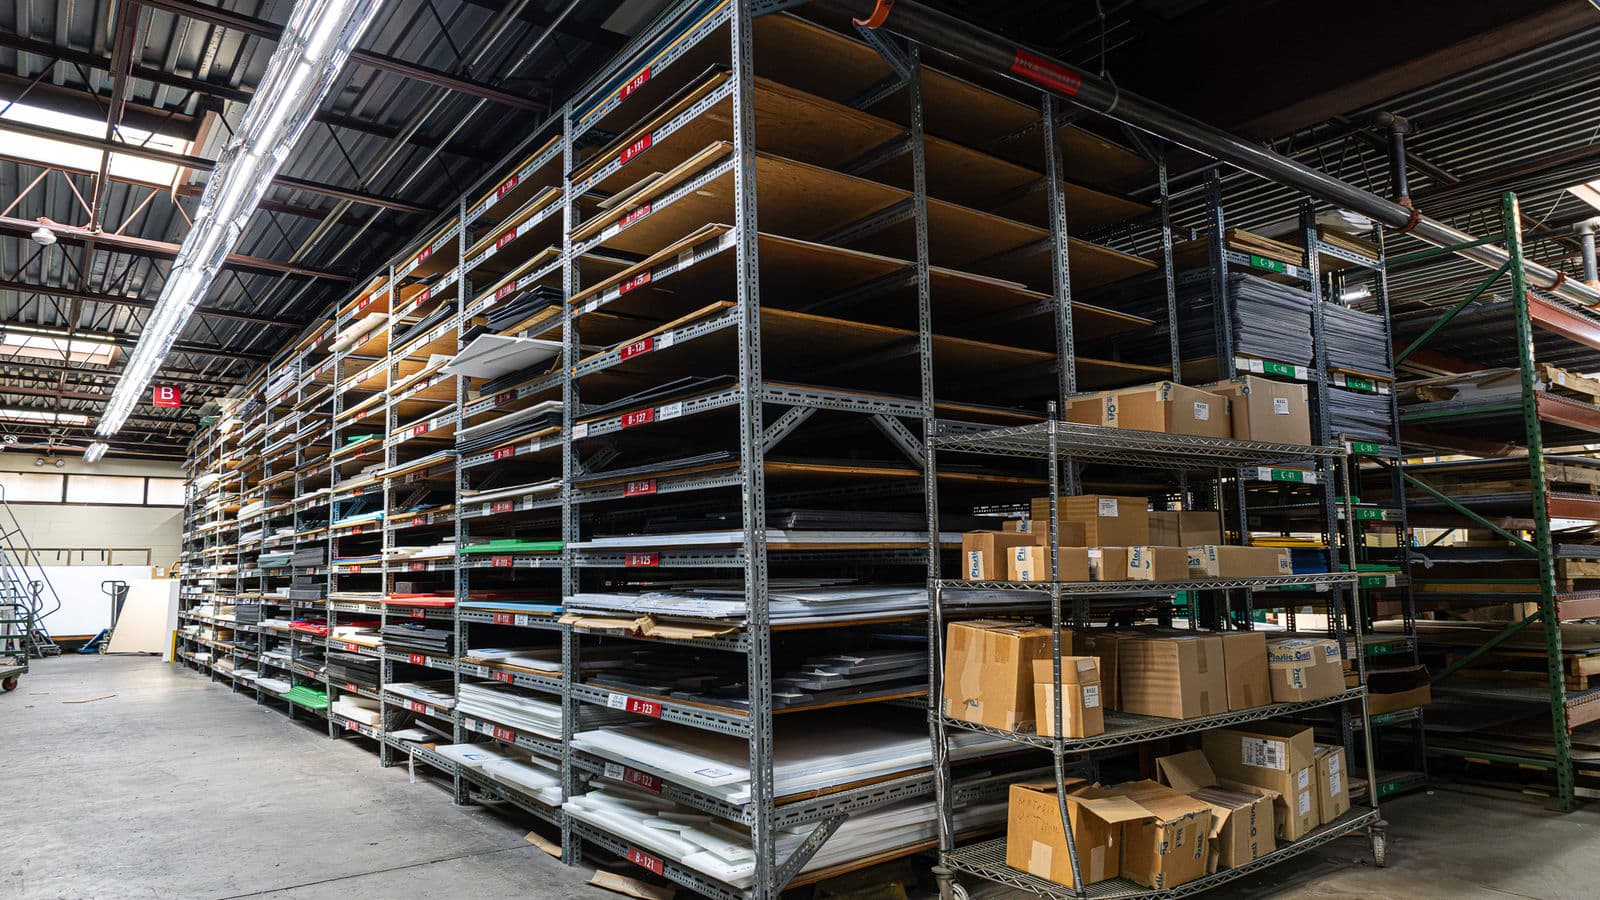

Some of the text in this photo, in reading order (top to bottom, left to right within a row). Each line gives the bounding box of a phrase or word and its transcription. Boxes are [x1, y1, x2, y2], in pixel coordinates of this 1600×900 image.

[625, 75, 644, 95] B-132
[626, 141, 645, 159] B-131
[161, 386, 174, 400] B
[627, 412, 647, 425] B-127
[630, 481, 649, 493] B-126
[631, 555, 651, 565] B-125
[633, 701, 653, 715] B-123
[633, 774, 653, 788] B-122
[635, 852, 655, 866] B-121
